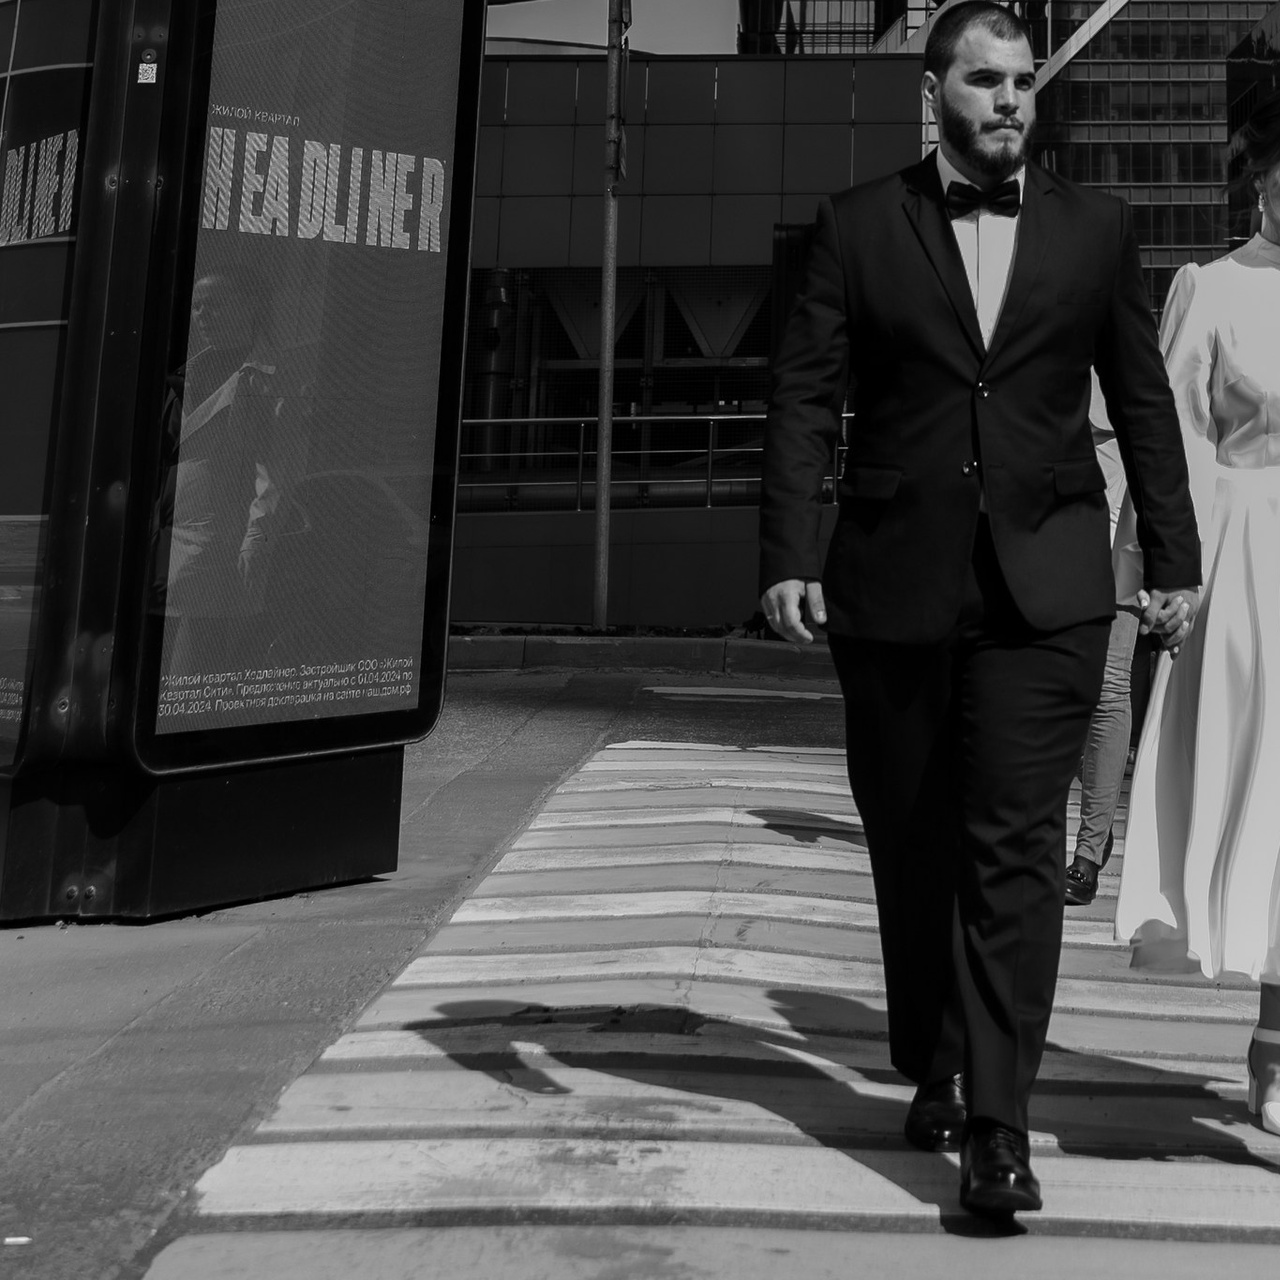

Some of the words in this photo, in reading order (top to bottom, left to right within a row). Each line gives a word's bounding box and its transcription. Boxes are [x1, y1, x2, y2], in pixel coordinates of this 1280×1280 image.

[211, 104, 252, 120] ЖИЛОЙ
[254, 110, 300, 127] КВАРТАЛ
[202, 126, 445, 253] HEADLINER
[202, 671, 243, 685] квартал
[299, 662, 356, 677] Застройщик
[357, 659, 378, 672] ООО
[402, 671, 414, 681] по
[323, 692, 334, 702] на
